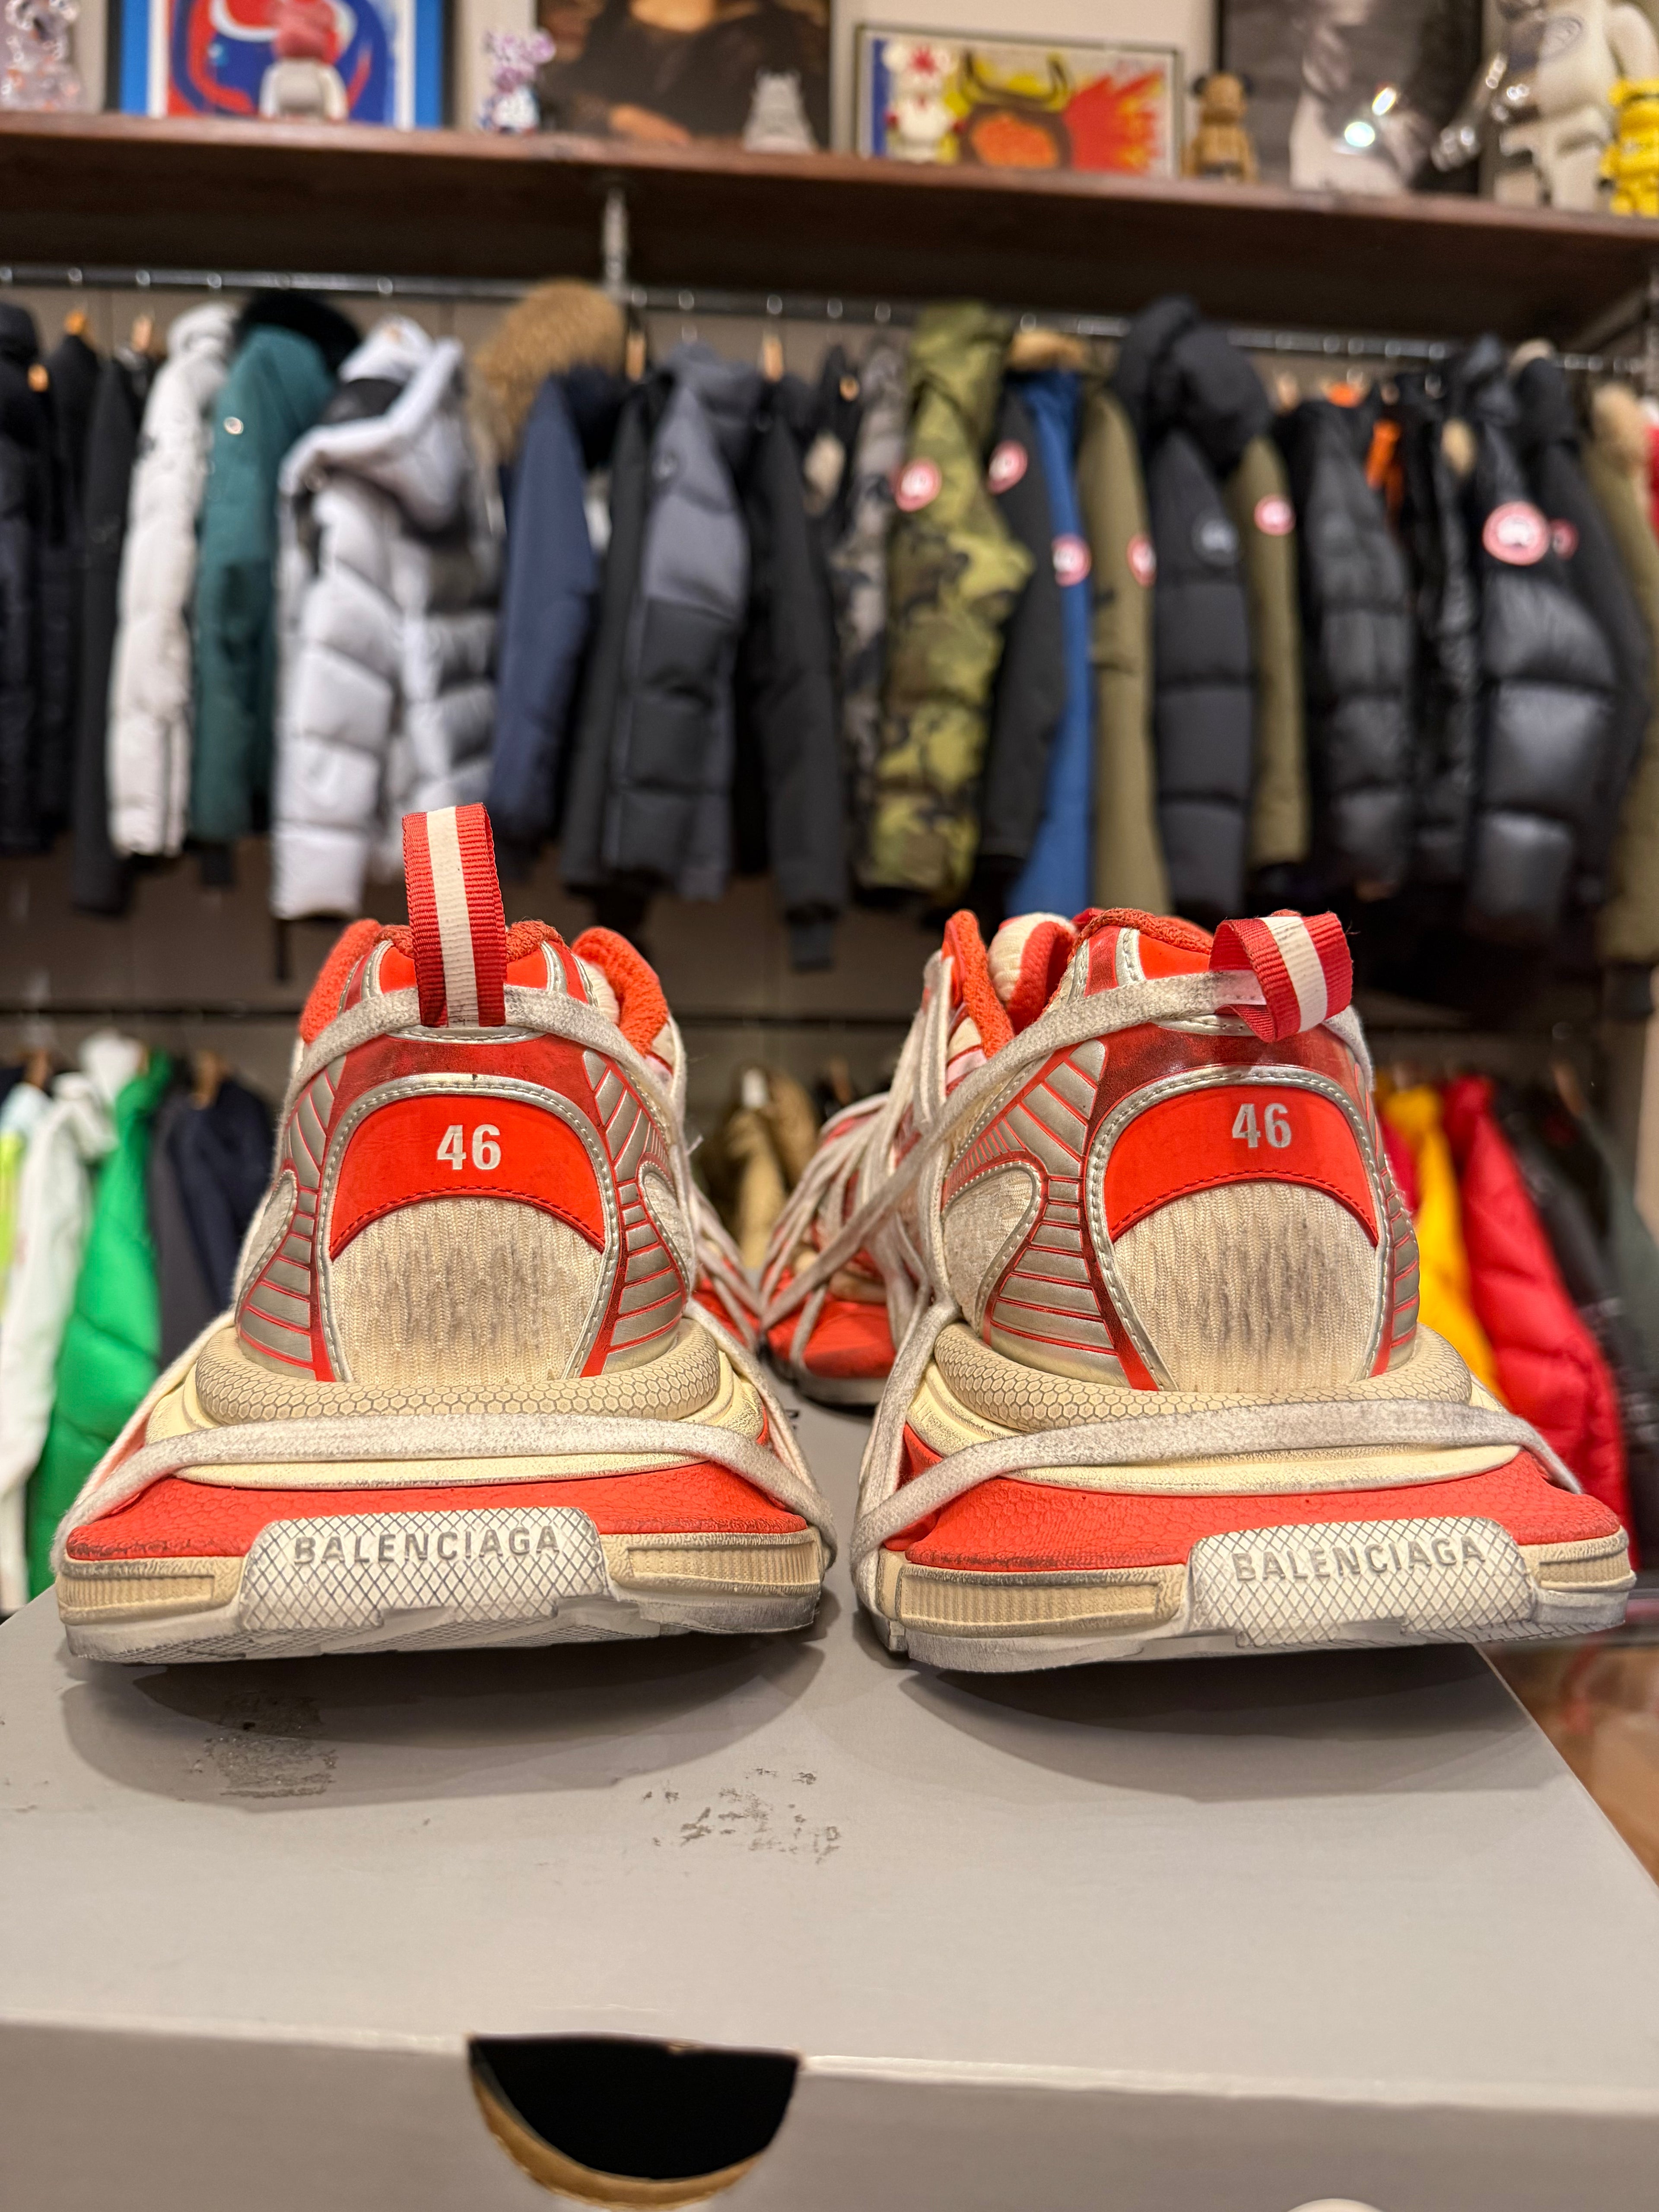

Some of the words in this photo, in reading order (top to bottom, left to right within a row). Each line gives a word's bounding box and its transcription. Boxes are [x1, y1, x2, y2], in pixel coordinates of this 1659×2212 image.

[436, 1124, 502, 1170] 46
[1232, 1103, 1292, 1148] 46
[294, 1525, 560, 1564] BALENCIAGA
[1231, 1535, 1486, 1582] BALENCIAGA
